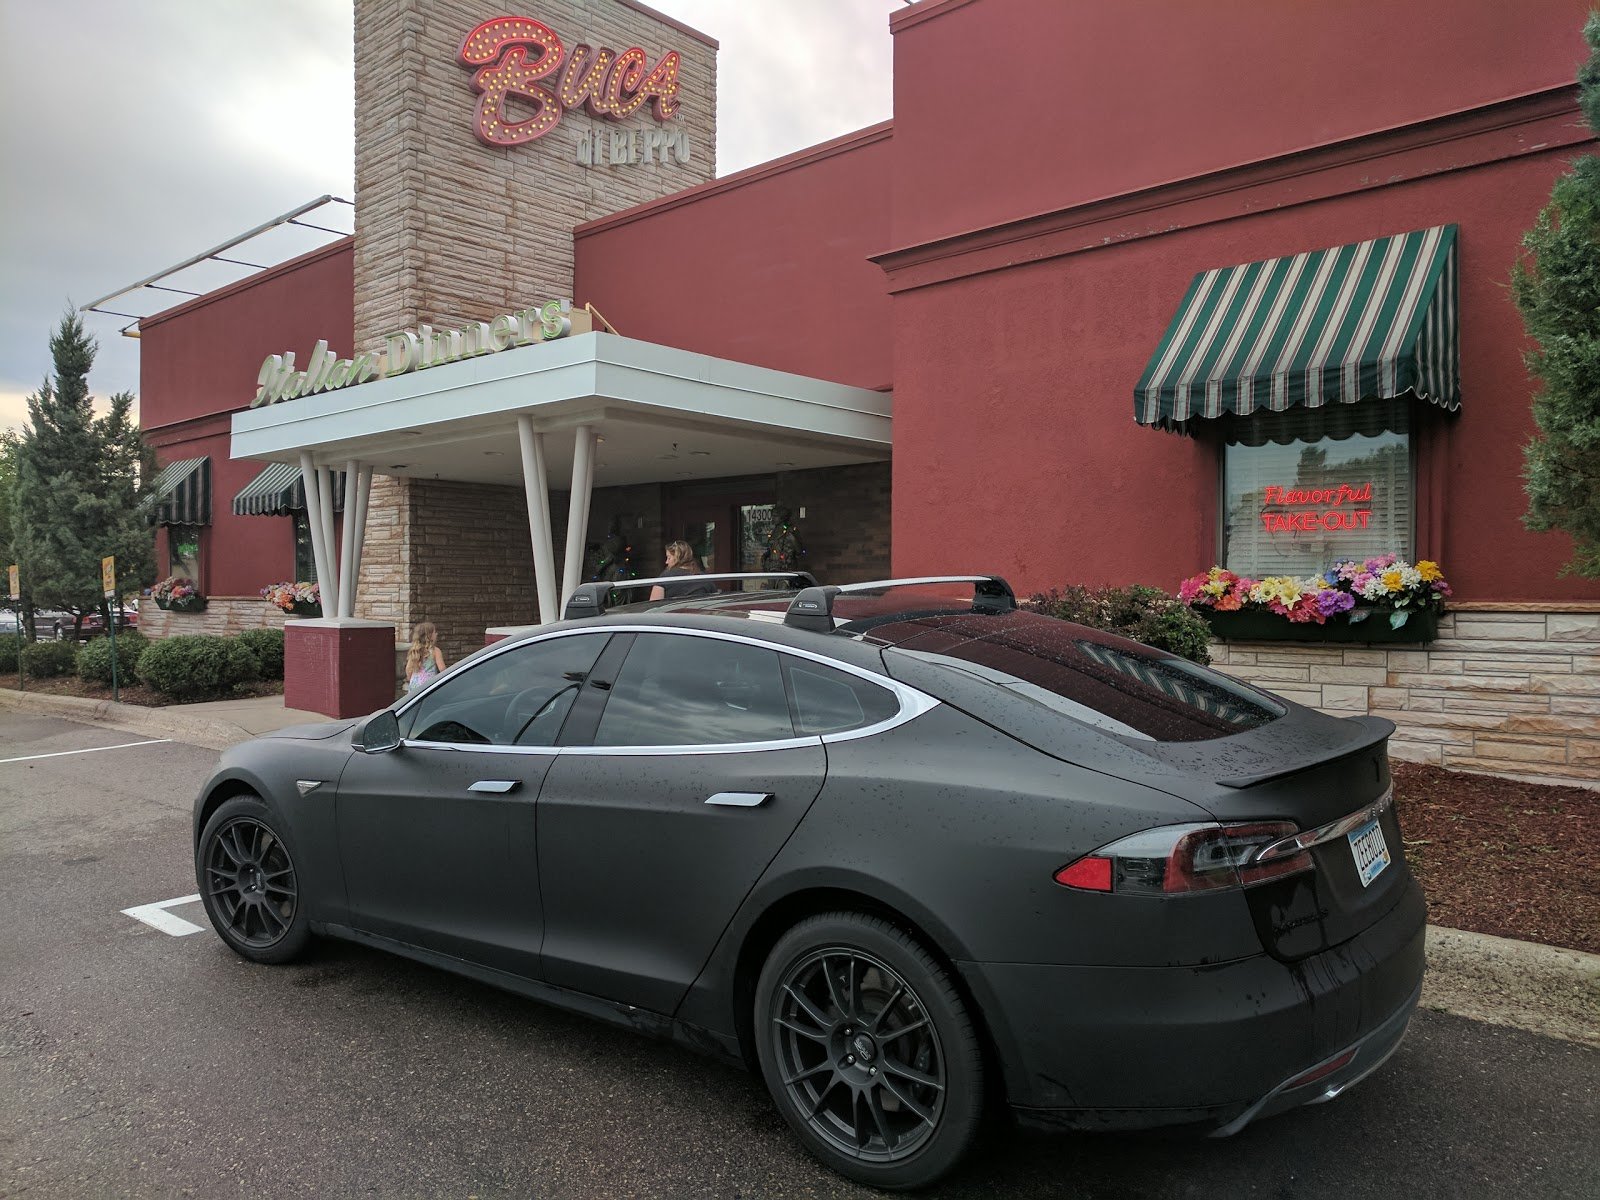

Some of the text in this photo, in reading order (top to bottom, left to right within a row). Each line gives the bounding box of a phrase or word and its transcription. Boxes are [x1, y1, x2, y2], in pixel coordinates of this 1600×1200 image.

[609, 129, 690, 165] BEPPO
[251, 299, 571, 407] Italian Dinners
[1264, 482, 1372, 505] Flavorful
[747, 509, 772, 521] 14300
[1262, 510, 1372, 532] TAKE-OUT
